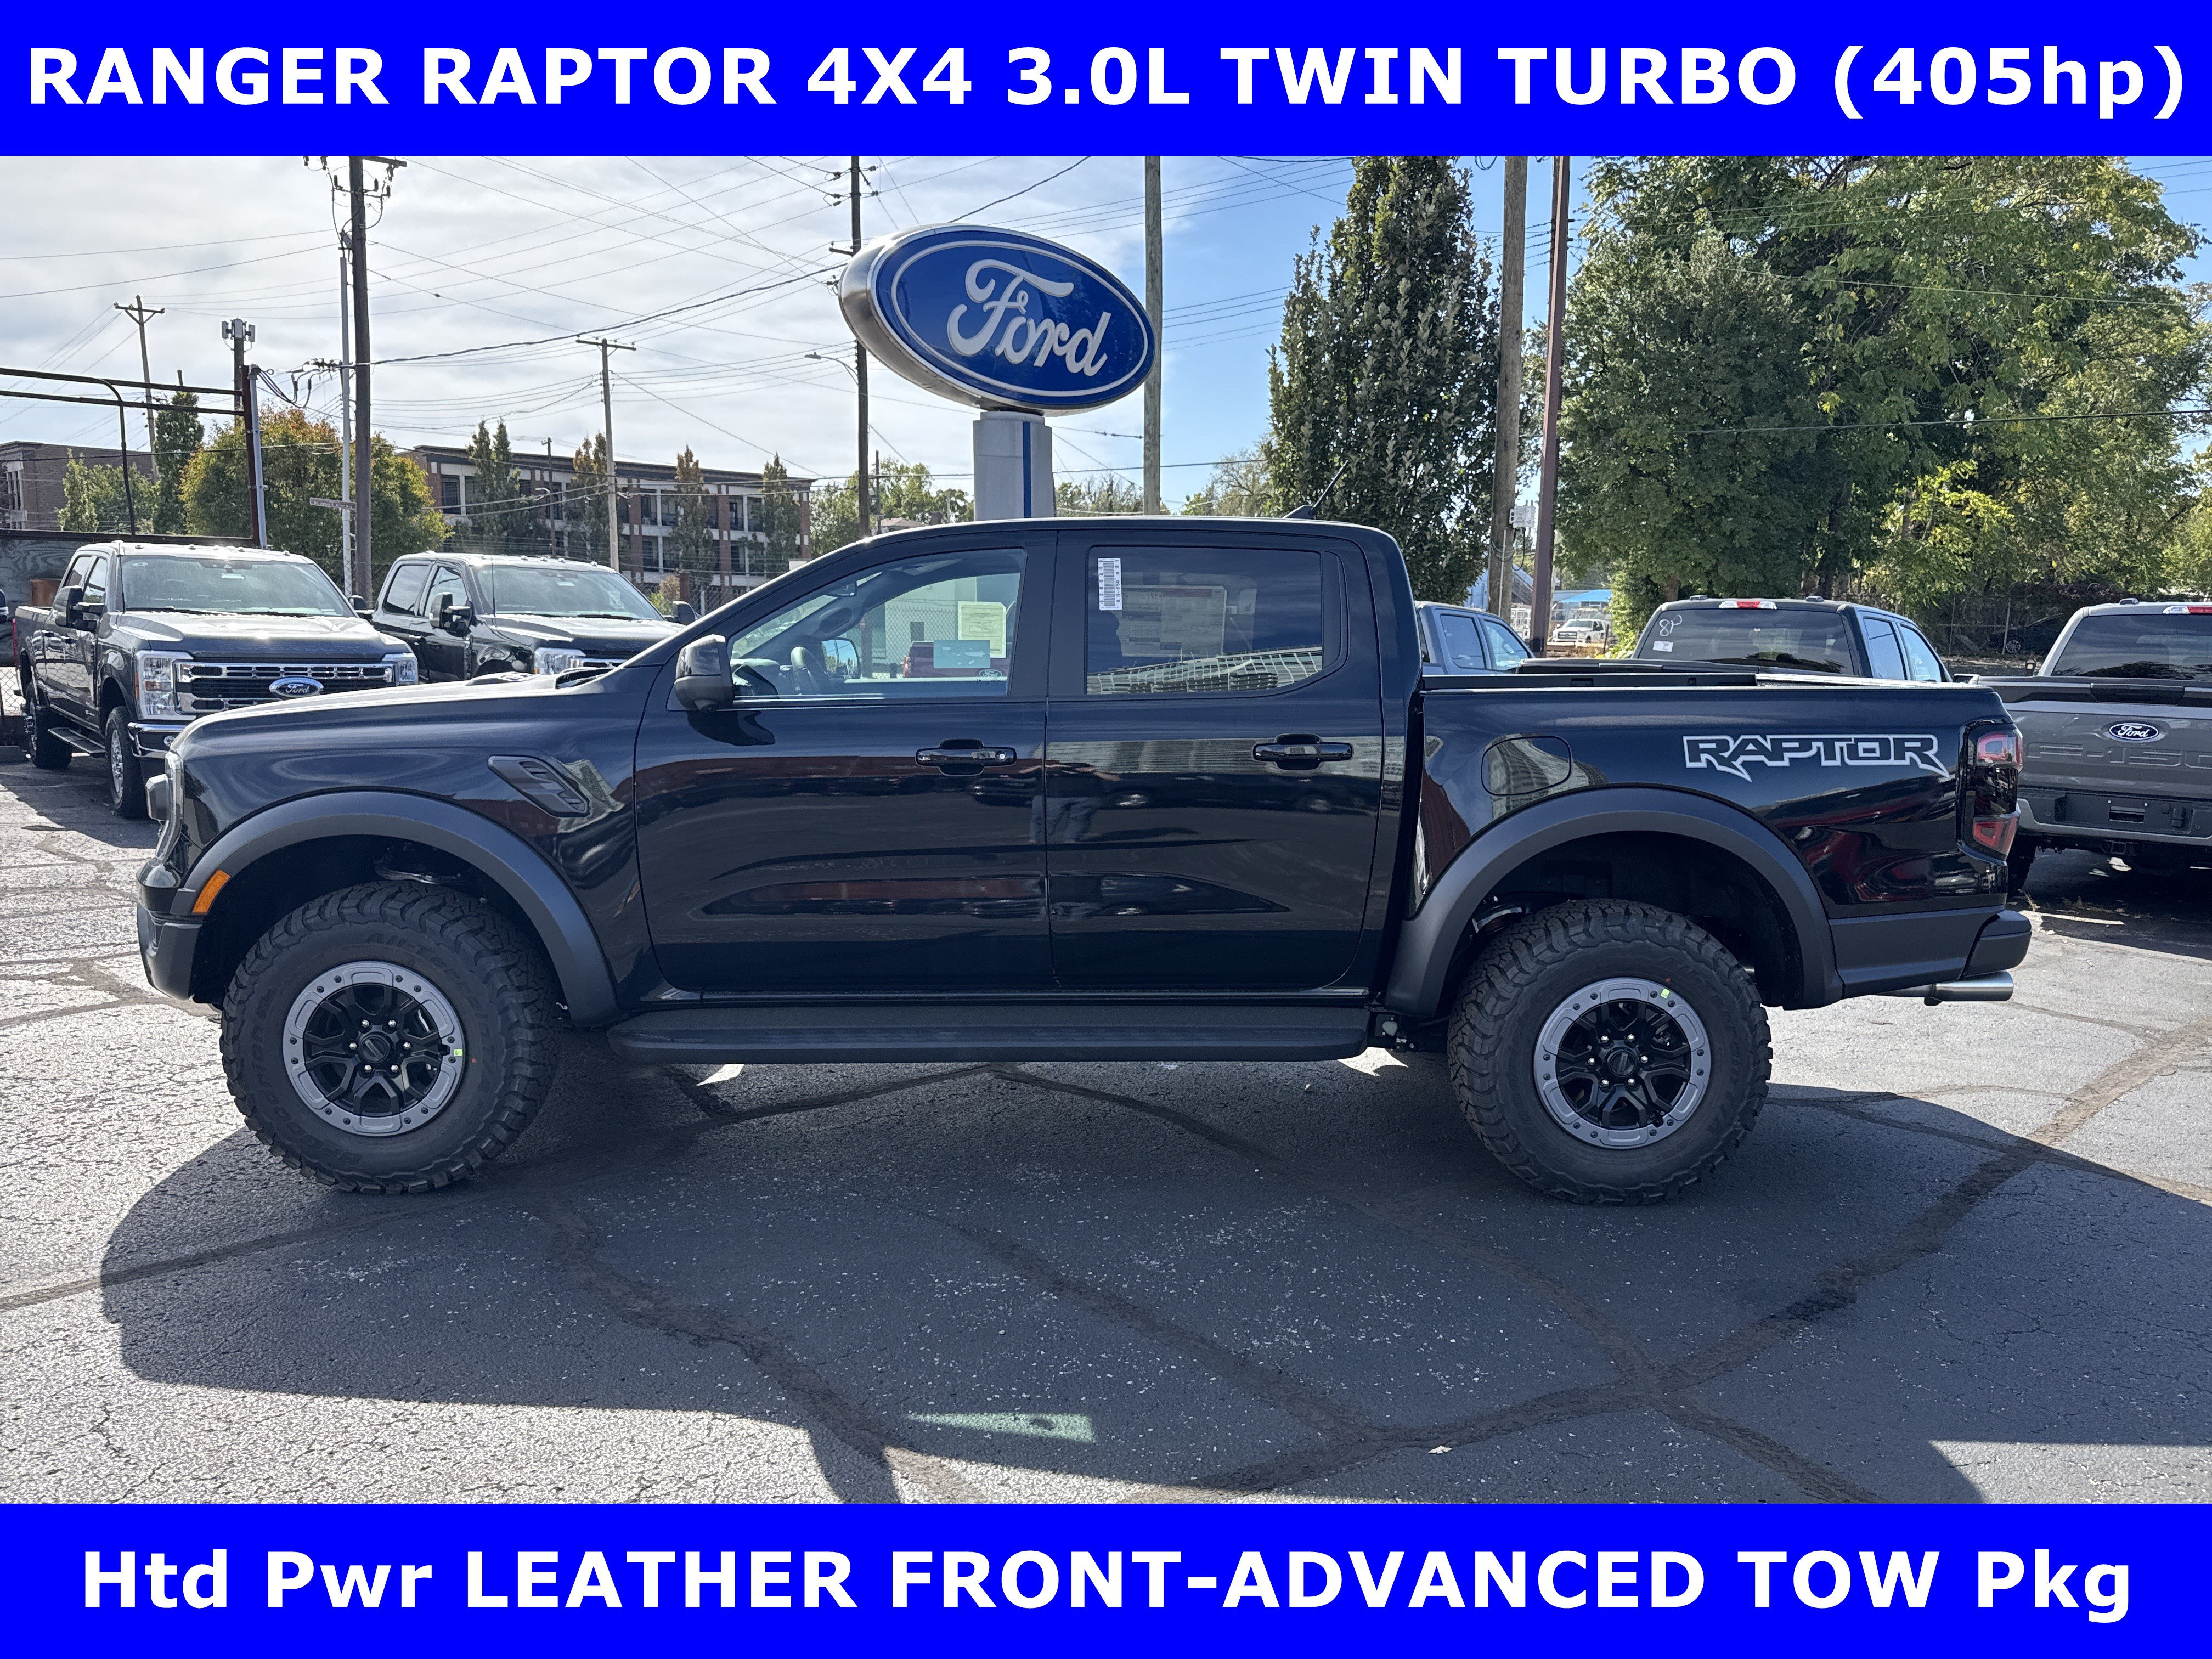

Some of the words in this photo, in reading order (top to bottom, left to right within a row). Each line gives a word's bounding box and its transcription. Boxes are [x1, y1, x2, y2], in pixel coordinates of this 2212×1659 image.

[947, 258, 1112, 377] Ford
[285, 684, 311, 694] Ford
[2117, 725, 2149, 738] Ford
[1683, 733, 1950, 783] RAPTOR
[363, 933, 491, 1040] All-Terrain
